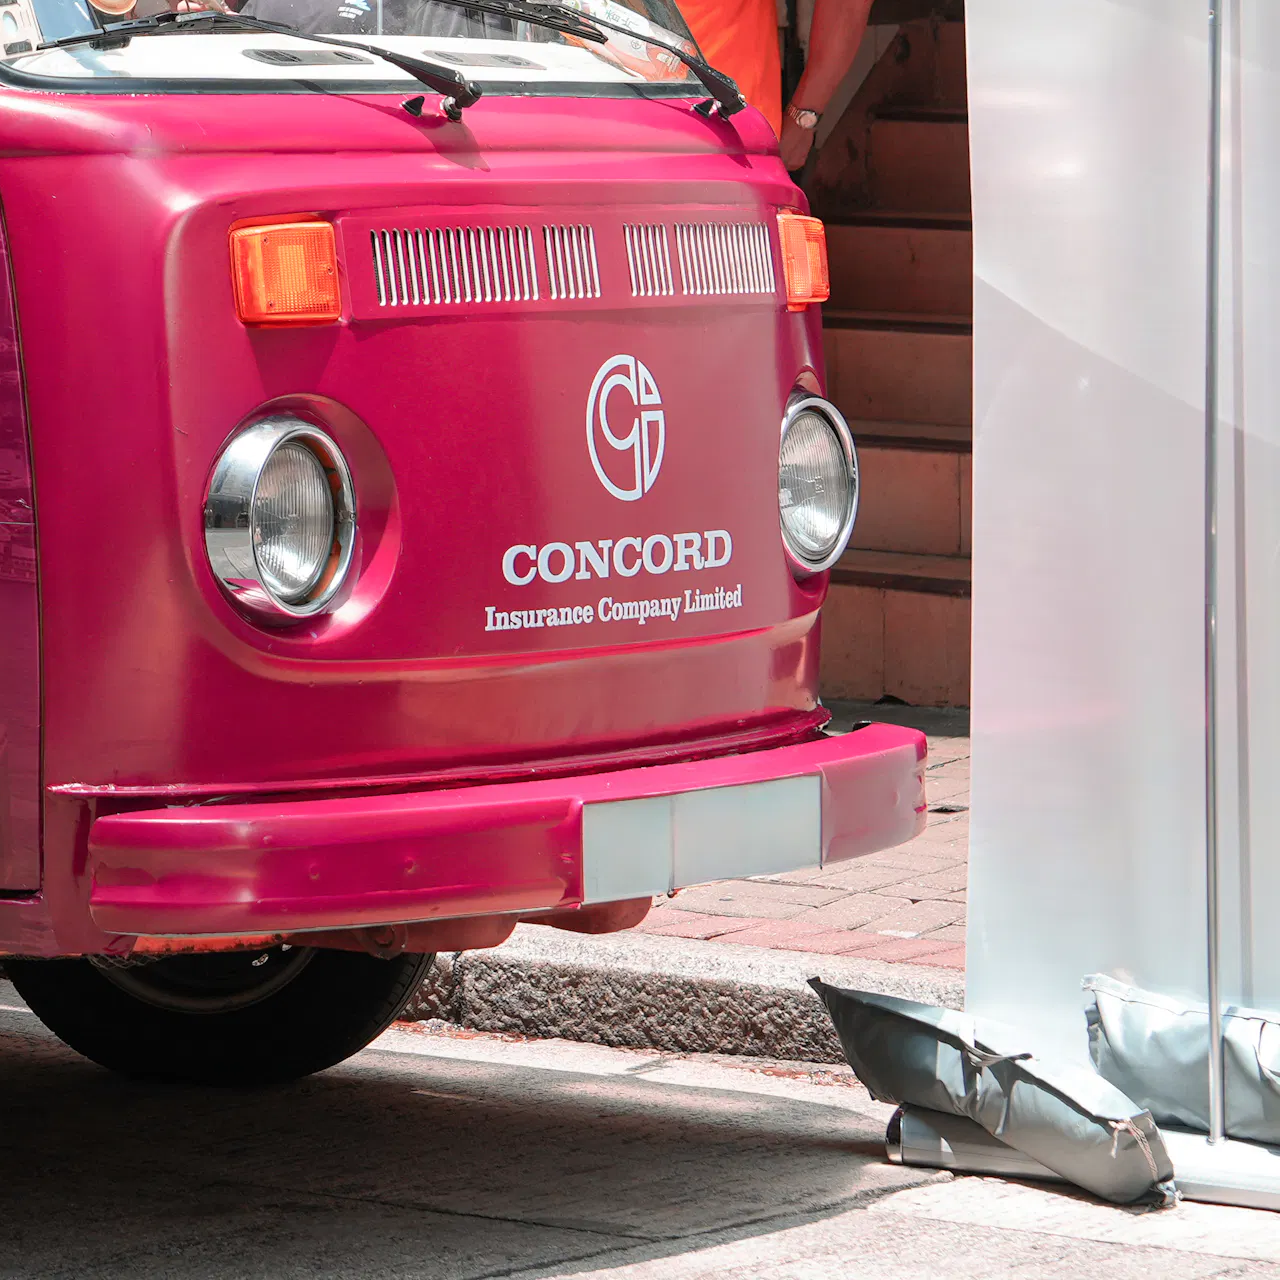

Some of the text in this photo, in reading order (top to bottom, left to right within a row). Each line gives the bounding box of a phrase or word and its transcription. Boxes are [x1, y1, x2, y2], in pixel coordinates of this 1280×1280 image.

[501, 529, 733, 586] CONCORD
[484, 583, 743, 633] Insurance Company Limited
